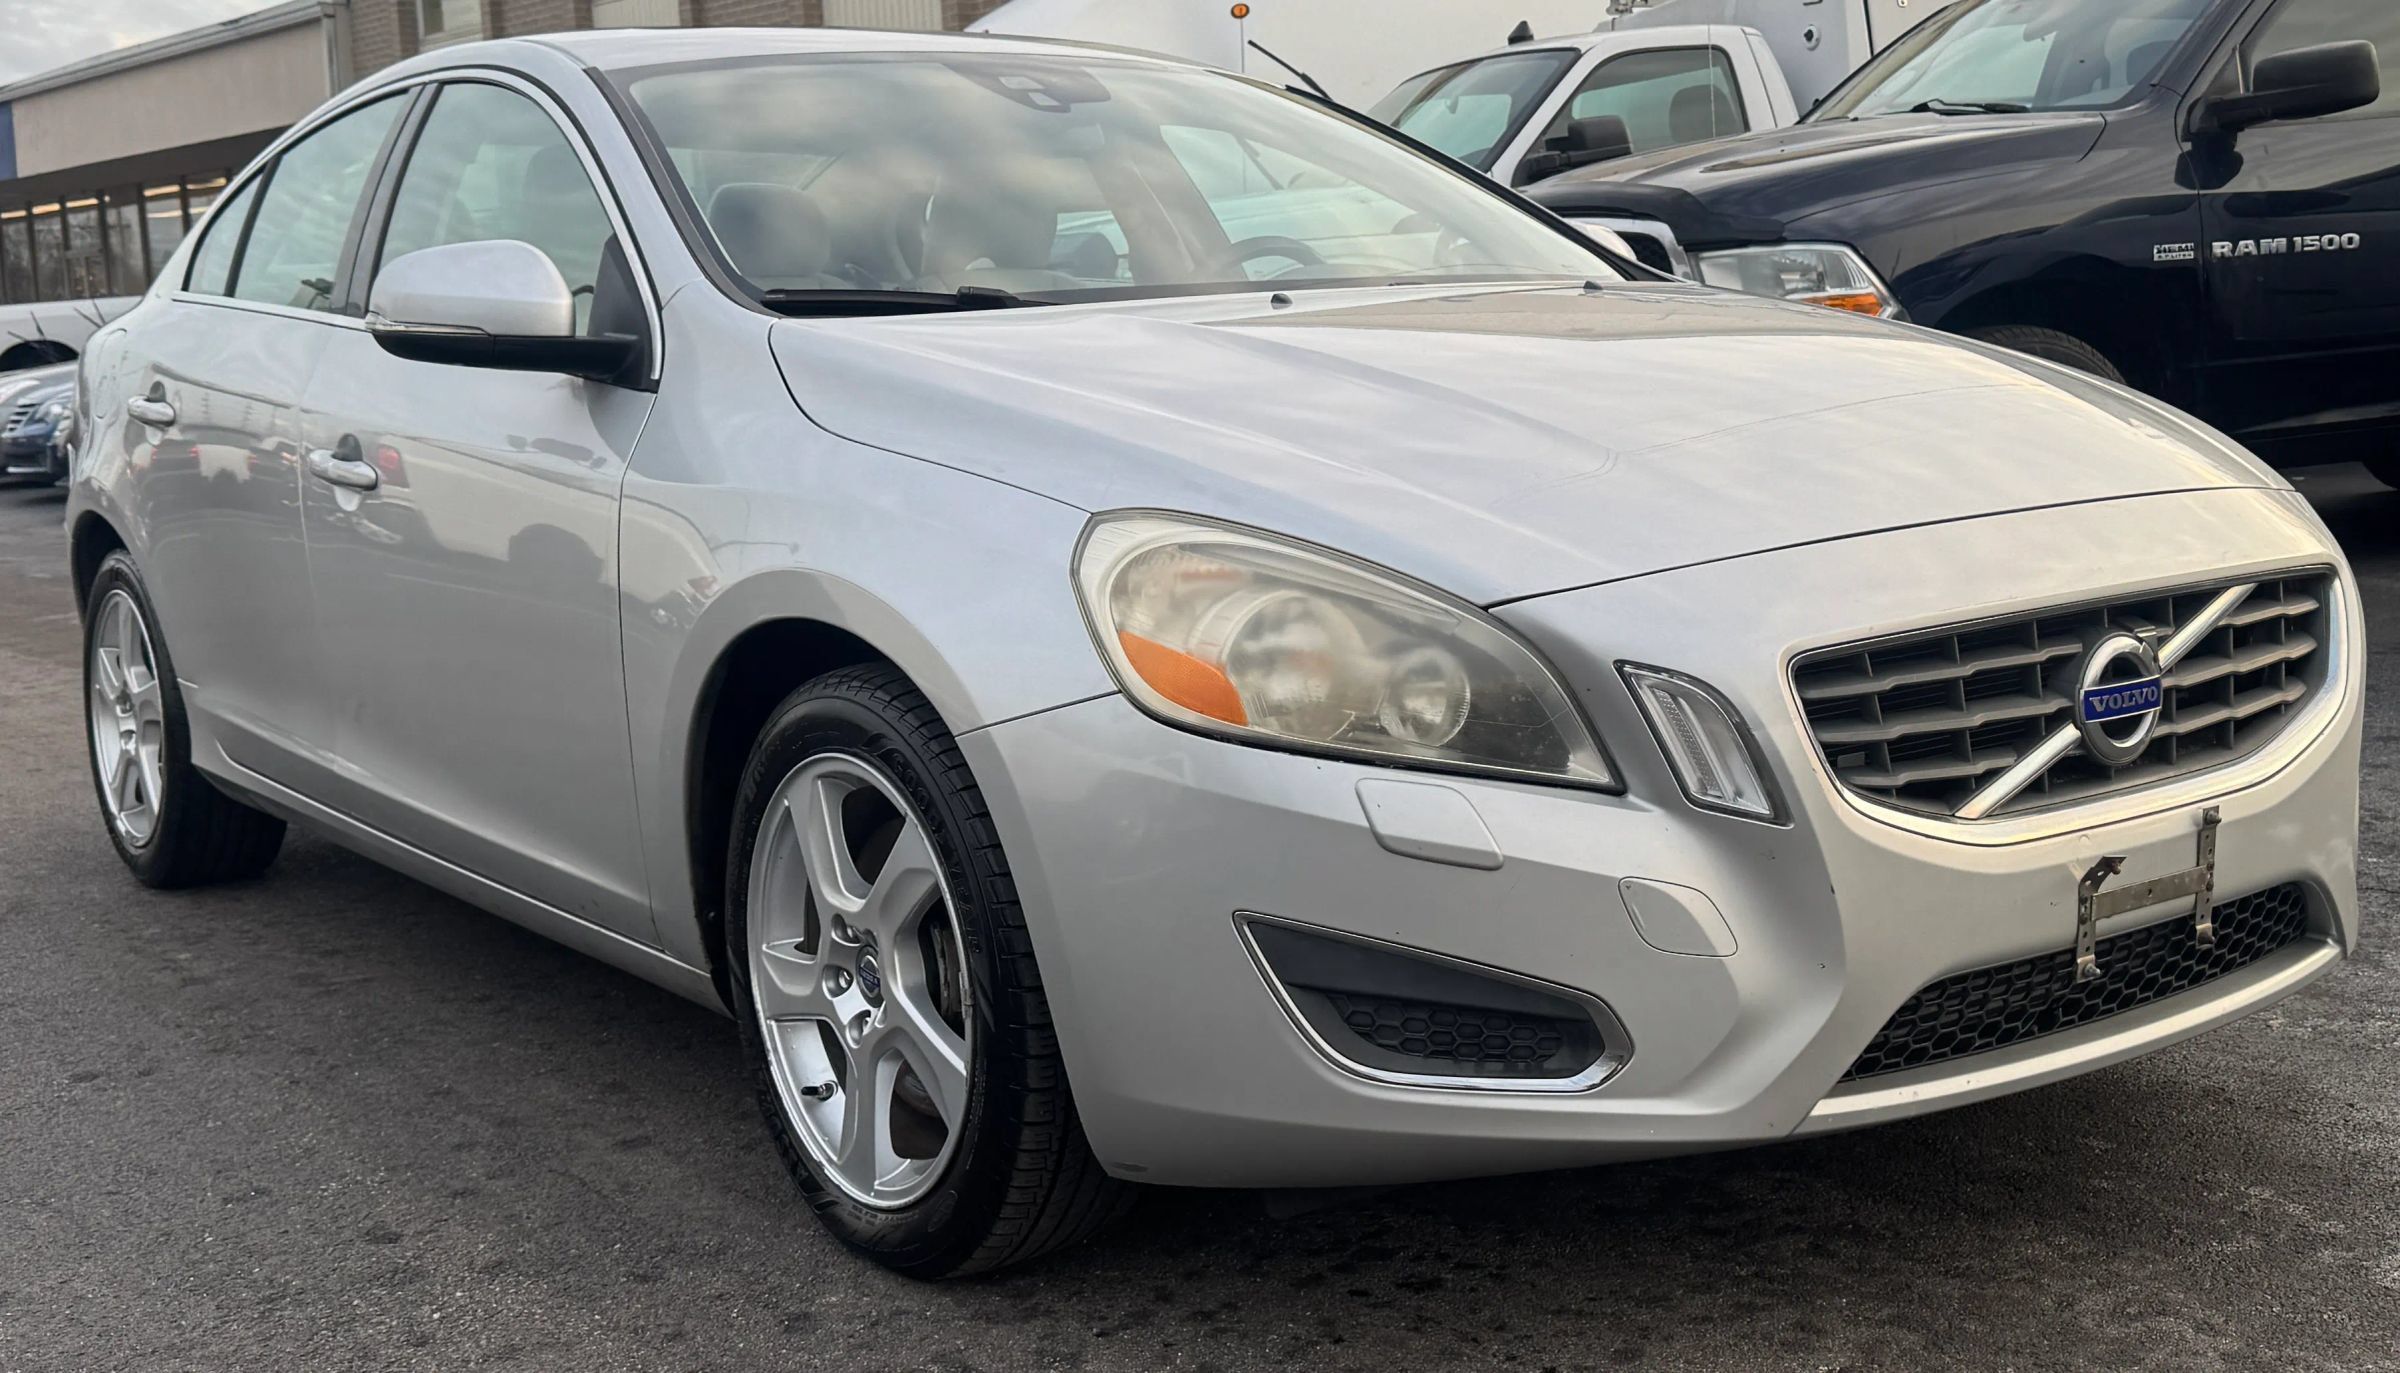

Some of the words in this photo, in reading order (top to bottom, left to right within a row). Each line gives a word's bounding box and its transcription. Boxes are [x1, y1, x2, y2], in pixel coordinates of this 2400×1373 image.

[2212, 238, 2287, 258] RAM
[2293, 233, 2361, 252] 1500
[2089, 686, 2158, 712] VOLVO
